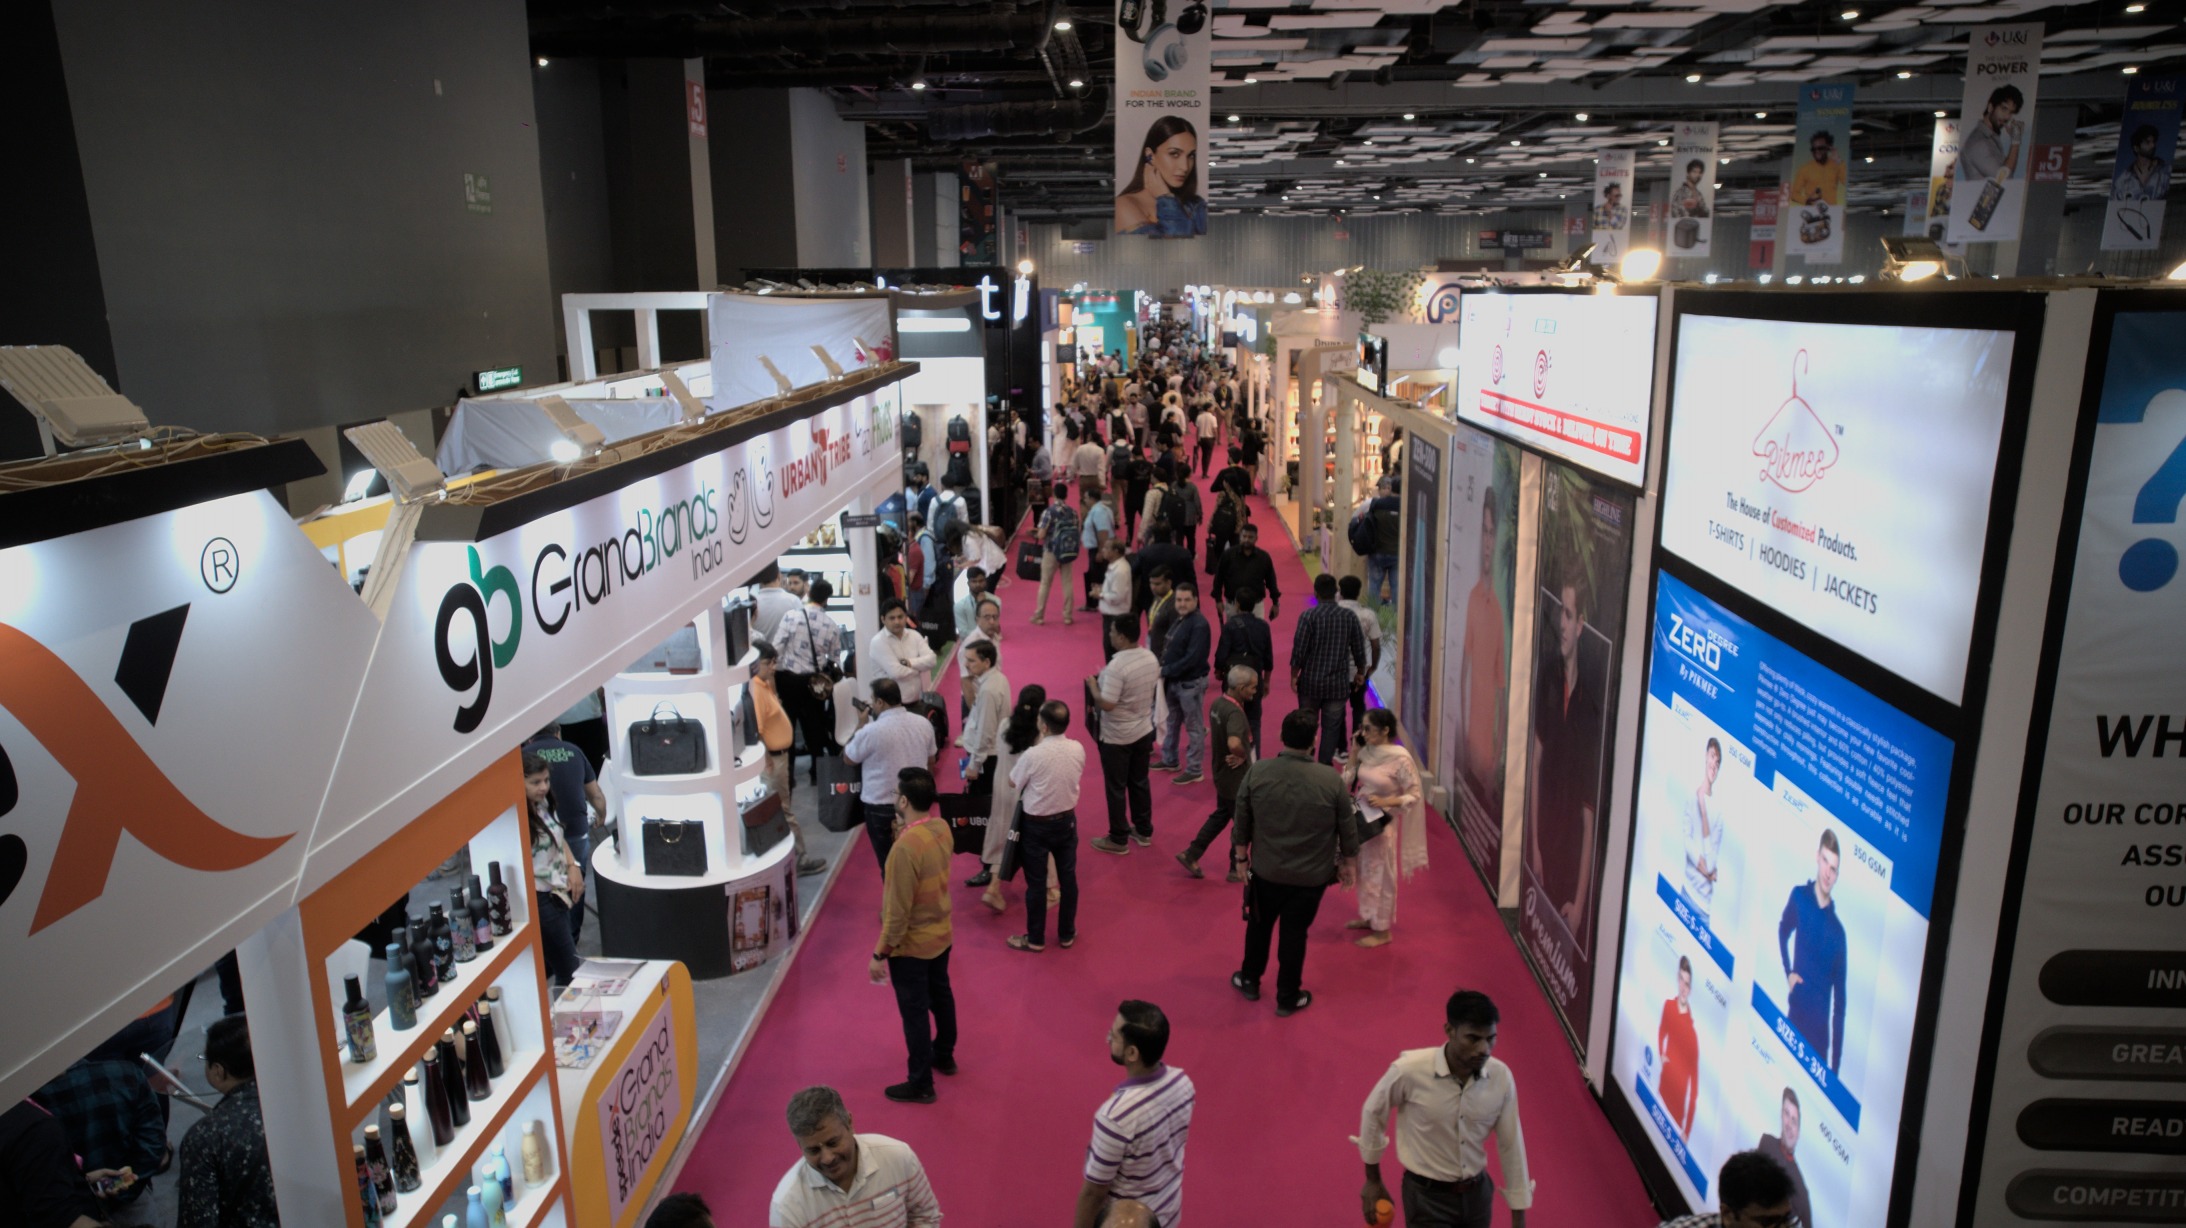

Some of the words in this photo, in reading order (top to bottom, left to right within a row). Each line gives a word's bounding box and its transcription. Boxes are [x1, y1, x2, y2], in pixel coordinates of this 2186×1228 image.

[1977, 62, 2028, 75] POWER
[1126, 100, 1144, 108] FOR
[1147, 100, 1164, 108] THE
[1167, 100, 1201, 108] WORLD
[1130, 90, 1162, 98] INDIAN
[1164, 90, 1197, 98] BRAND
[781, 450, 822, 499] URBAN
[828, 432, 851, 472] TRIBE
[1726, 491, 1738, 512] The
[1739, 496, 1760, 521] House
[1762, 506, 1772, 526] of
[1772, 510, 1816, 544] Customized
[1818, 527, 1858, 561] Products.
[693, 538, 722, 581] India
[1709, 520, 1744, 551] T-SHIRTS
[1760, 544, 1806, 580] HOODIES
[1824, 574, 1878, 614] JACKETS
[1668, 612, 1720, 672] ZERO
[1706, 628, 1740, 658] DEGREE
[1688, 668, 1719, 700] PIKMEE
[2064, 804, 2125, 825] OUR
[1854, 844, 1868, 864] 350
[1868, 856, 1886, 879] GSM
[2121, 845, 2186, 867] ASS
[1526, 886, 1578, 1000] Premium
[620, 1016, 669, 1115] Grand
[2112, 1043, 2186, 1064] GREA
[1810, 1056, 1828, 1089] 3XL
[624, 1058, 672, 1154] Brands
[2111, 1117, 2186, 1138] READ
[628, 1106, 666, 1188] India
[1832, 1140, 1850, 1167] GSM
[2053, 1185, 2186, 1209] COMPETIT
